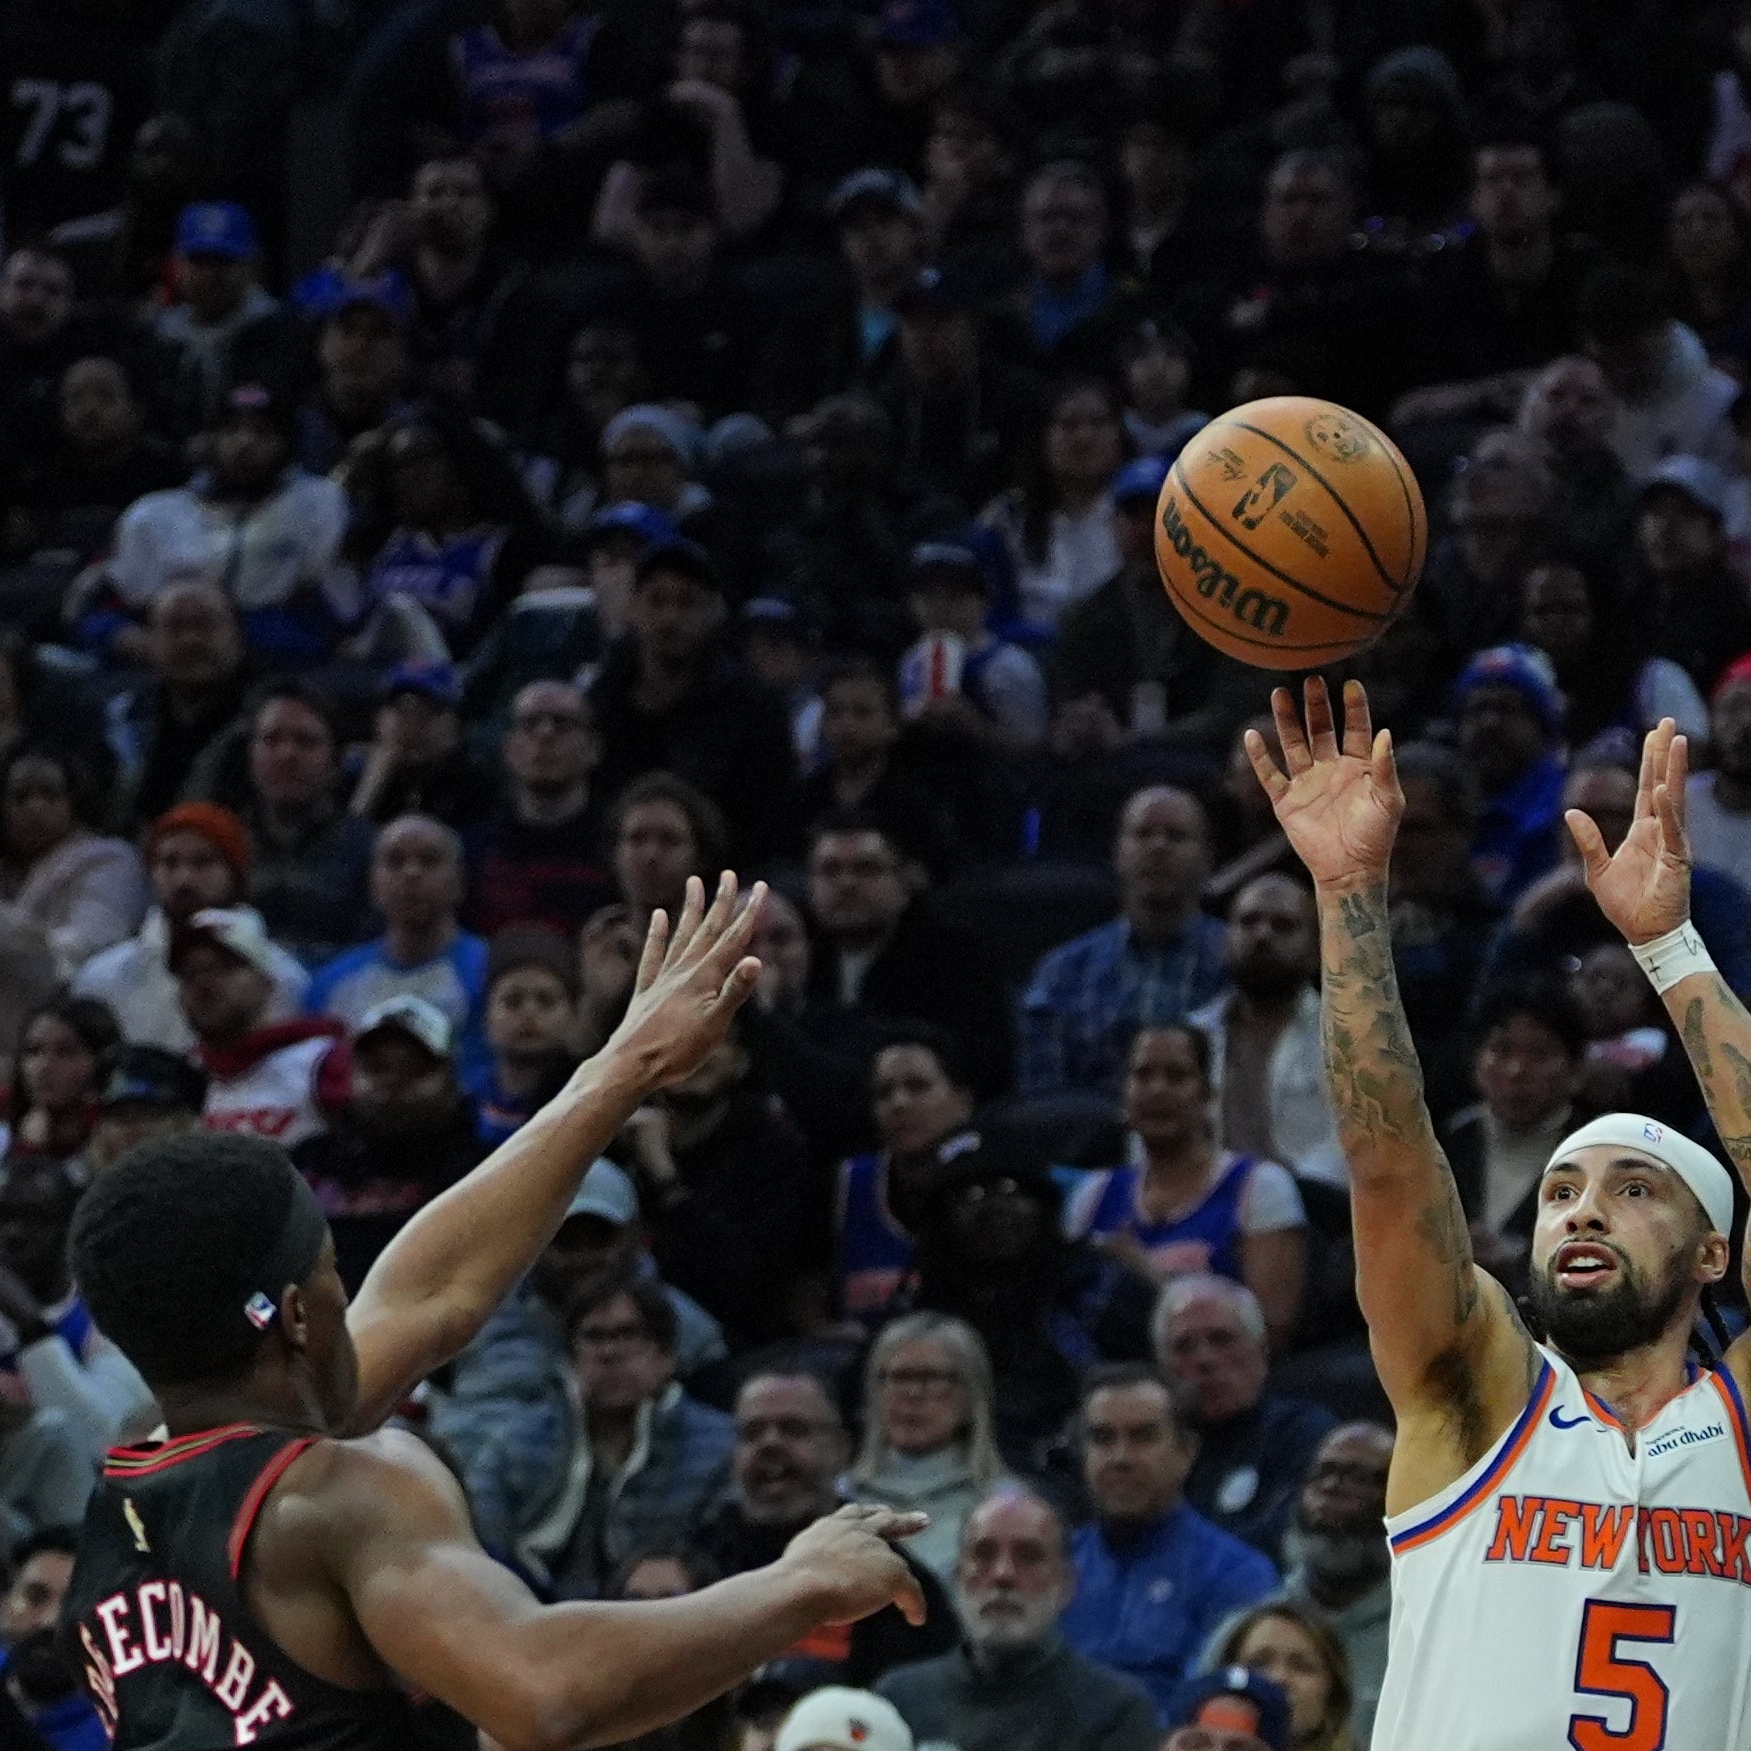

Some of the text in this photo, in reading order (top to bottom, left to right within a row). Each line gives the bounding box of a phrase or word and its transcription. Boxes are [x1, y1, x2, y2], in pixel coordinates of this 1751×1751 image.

[9, 75, 113, 171] 73
[1162, 496, 1291, 637] Wilson
[1647, 1437, 1680, 1458] abu
[1482, 1494, 1636, 1573] NEW
